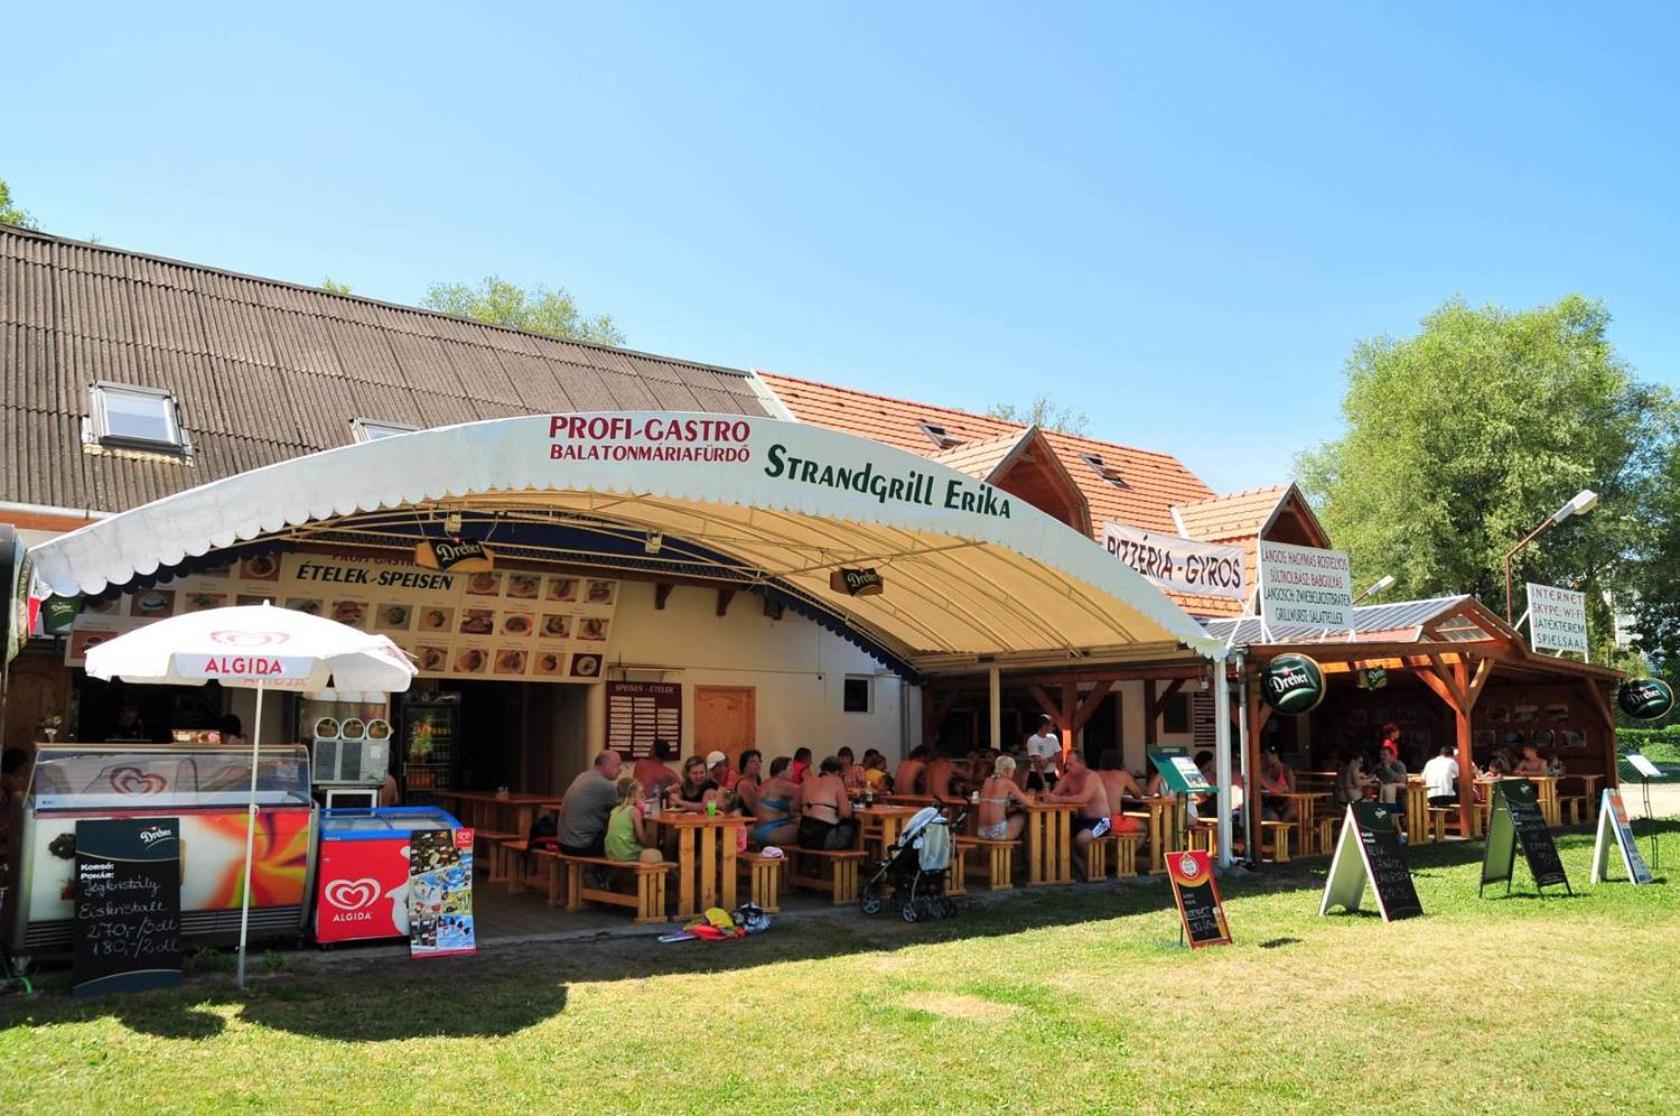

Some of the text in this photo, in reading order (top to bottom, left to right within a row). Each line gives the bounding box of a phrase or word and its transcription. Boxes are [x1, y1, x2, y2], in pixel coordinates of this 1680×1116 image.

[549, 415, 750, 442] PROFI-GASTRO
[436, 541, 482, 561] Dreher
[1185, 554, 1241, 589] GYROS
[1531, 586, 1583, 605] INTERNET
[204, 657, 282, 675] ALGIDA
[1268, 672, 1309, 693] Dreher
[333, 912, 371, 922] ALGIDA
